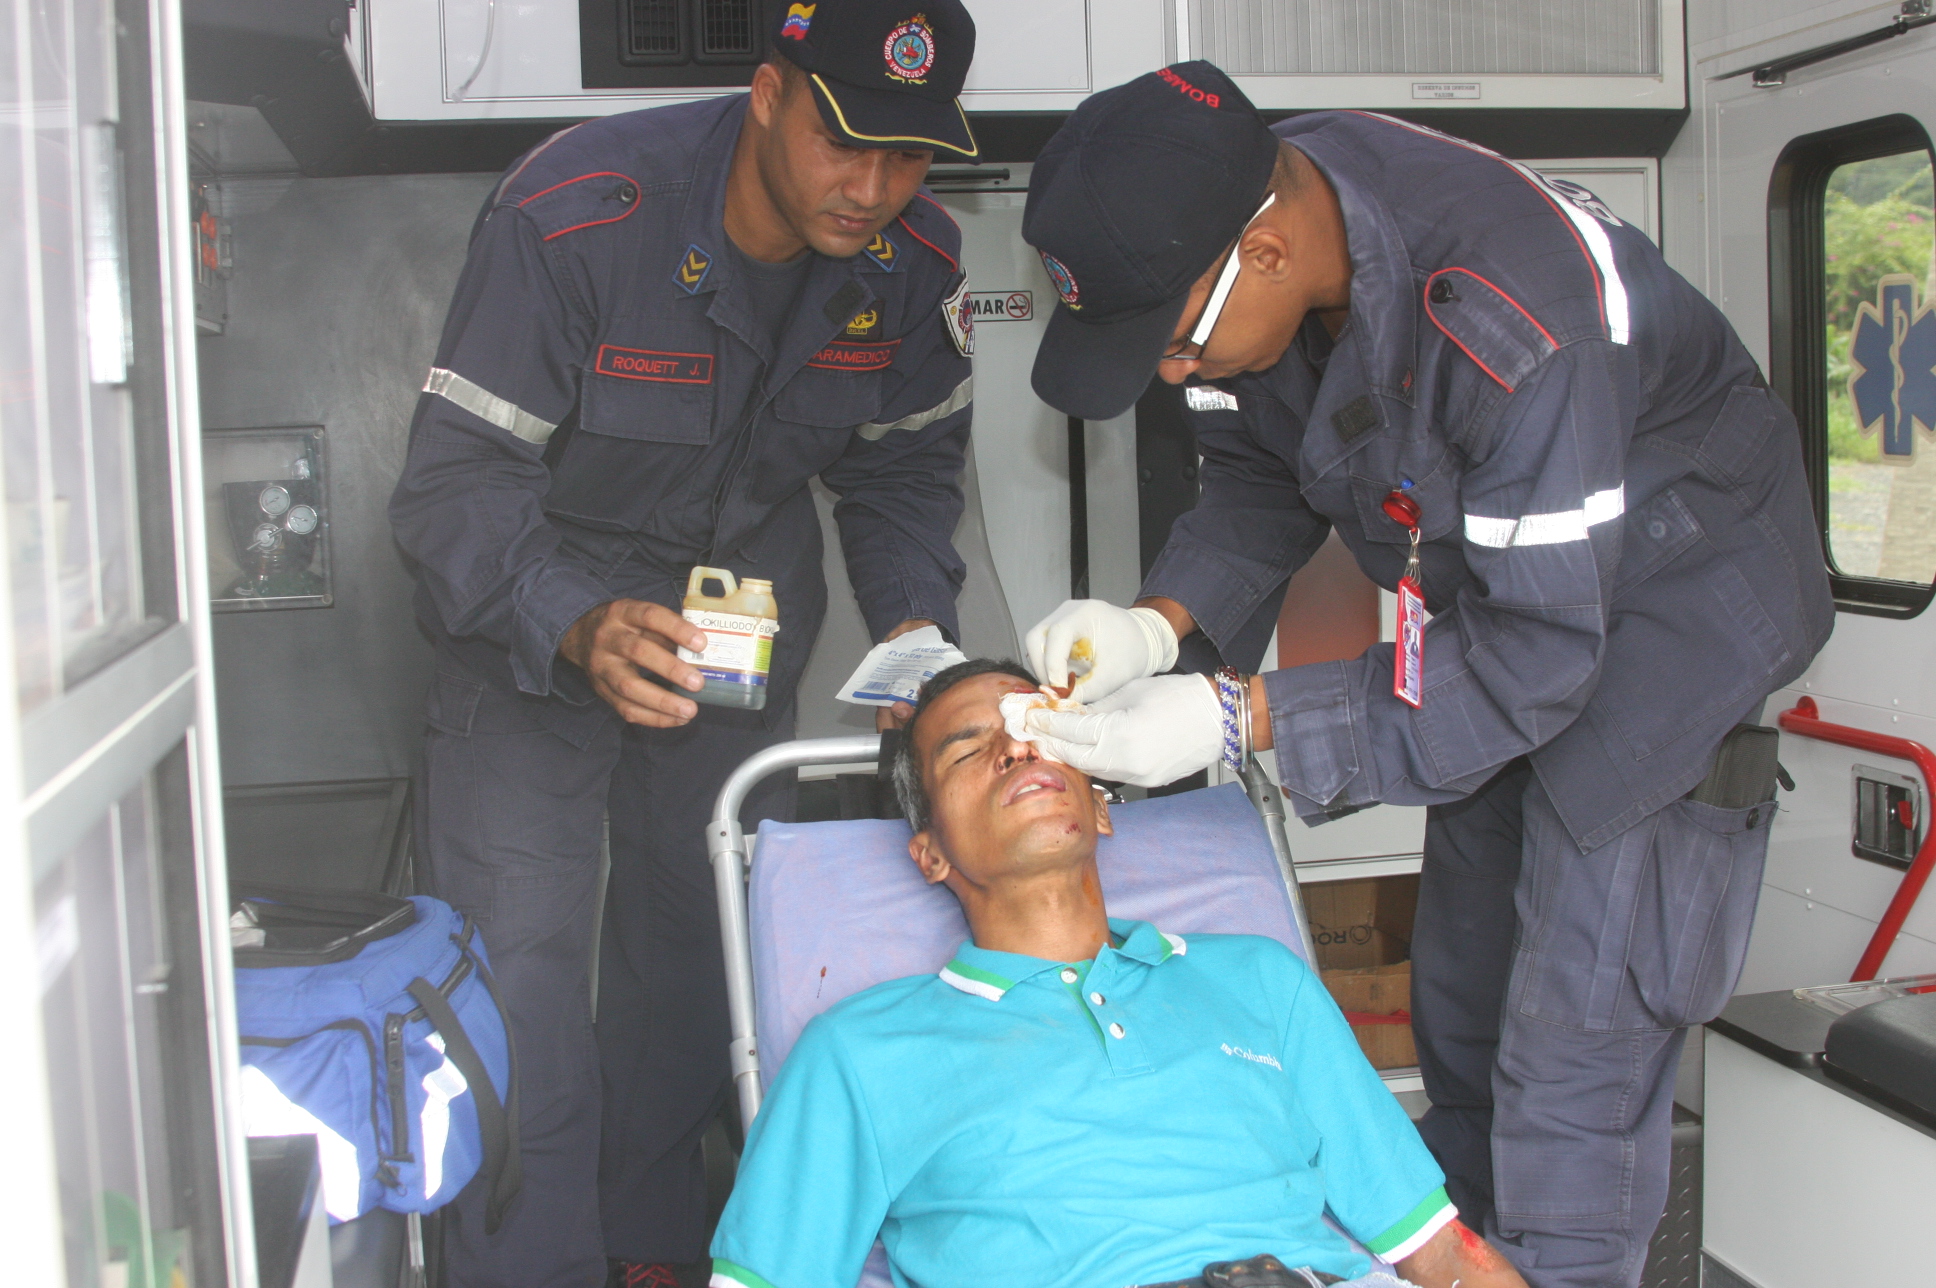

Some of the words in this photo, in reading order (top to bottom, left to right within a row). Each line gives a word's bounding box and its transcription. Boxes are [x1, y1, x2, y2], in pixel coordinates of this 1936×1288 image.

[884, 31, 899, 60] CUERPO
[898, 26, 908, 36] DE
[919, 30, 935, 68] BOMBEROS
[889, 61, 926, 79] VENEZUELA
[612, 355, 679, 375] ROQUETT
[688, 362, 701, 376] J.
